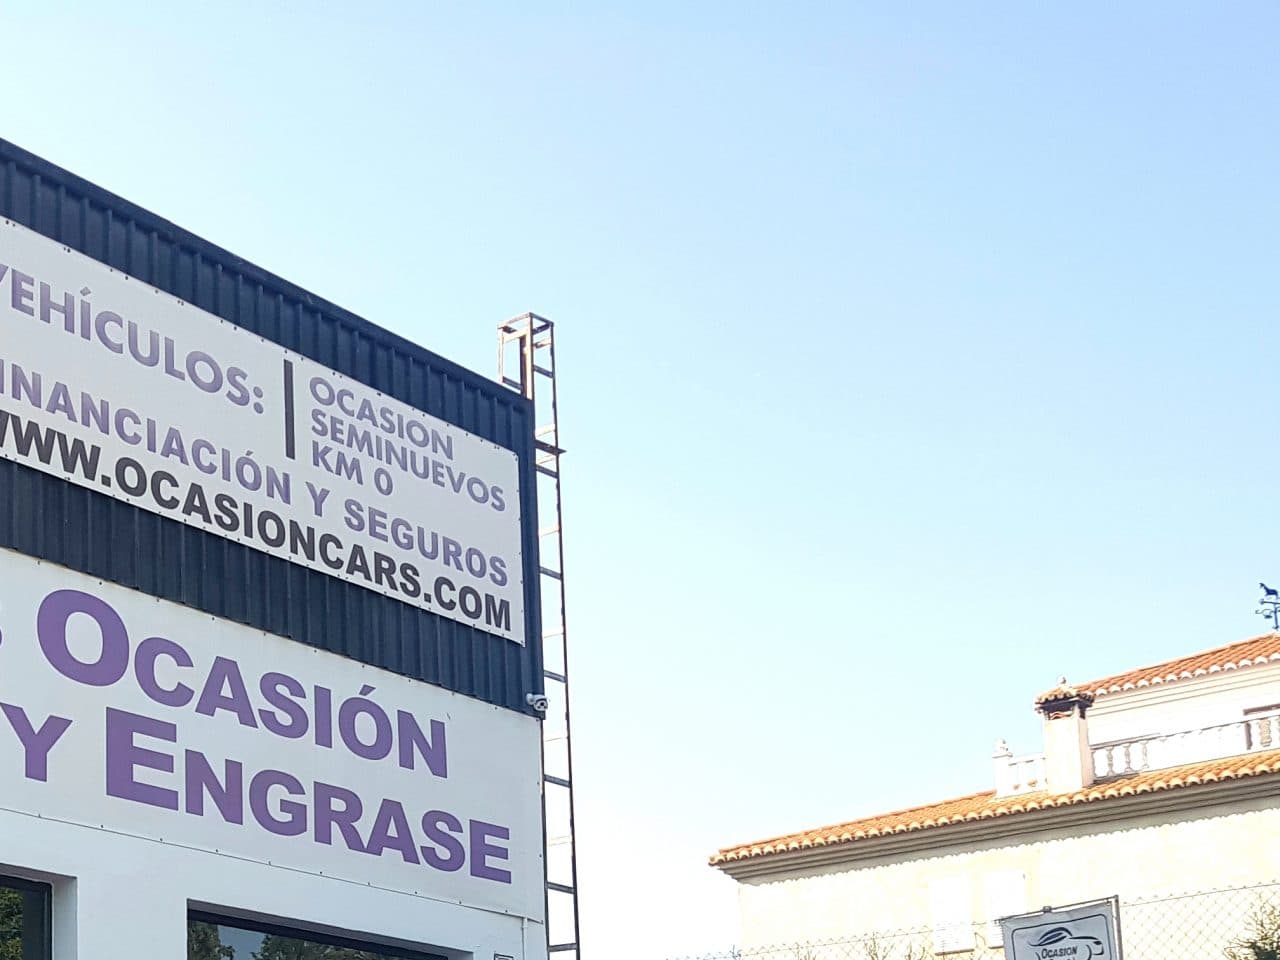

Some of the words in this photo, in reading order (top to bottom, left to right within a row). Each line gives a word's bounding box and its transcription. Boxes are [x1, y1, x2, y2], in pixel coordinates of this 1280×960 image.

[310, 377, 454, 460] OCASION
[311, 408, 506, 512] SEMINUEVOS
[312, 440, 363, 485] KM
[305, 481, 330, 517] Y
[344, 499, 508, 587] SEGUROS
[0, 702, 72, 783] Y
[106, 707, 512, 884] ENGRASE
